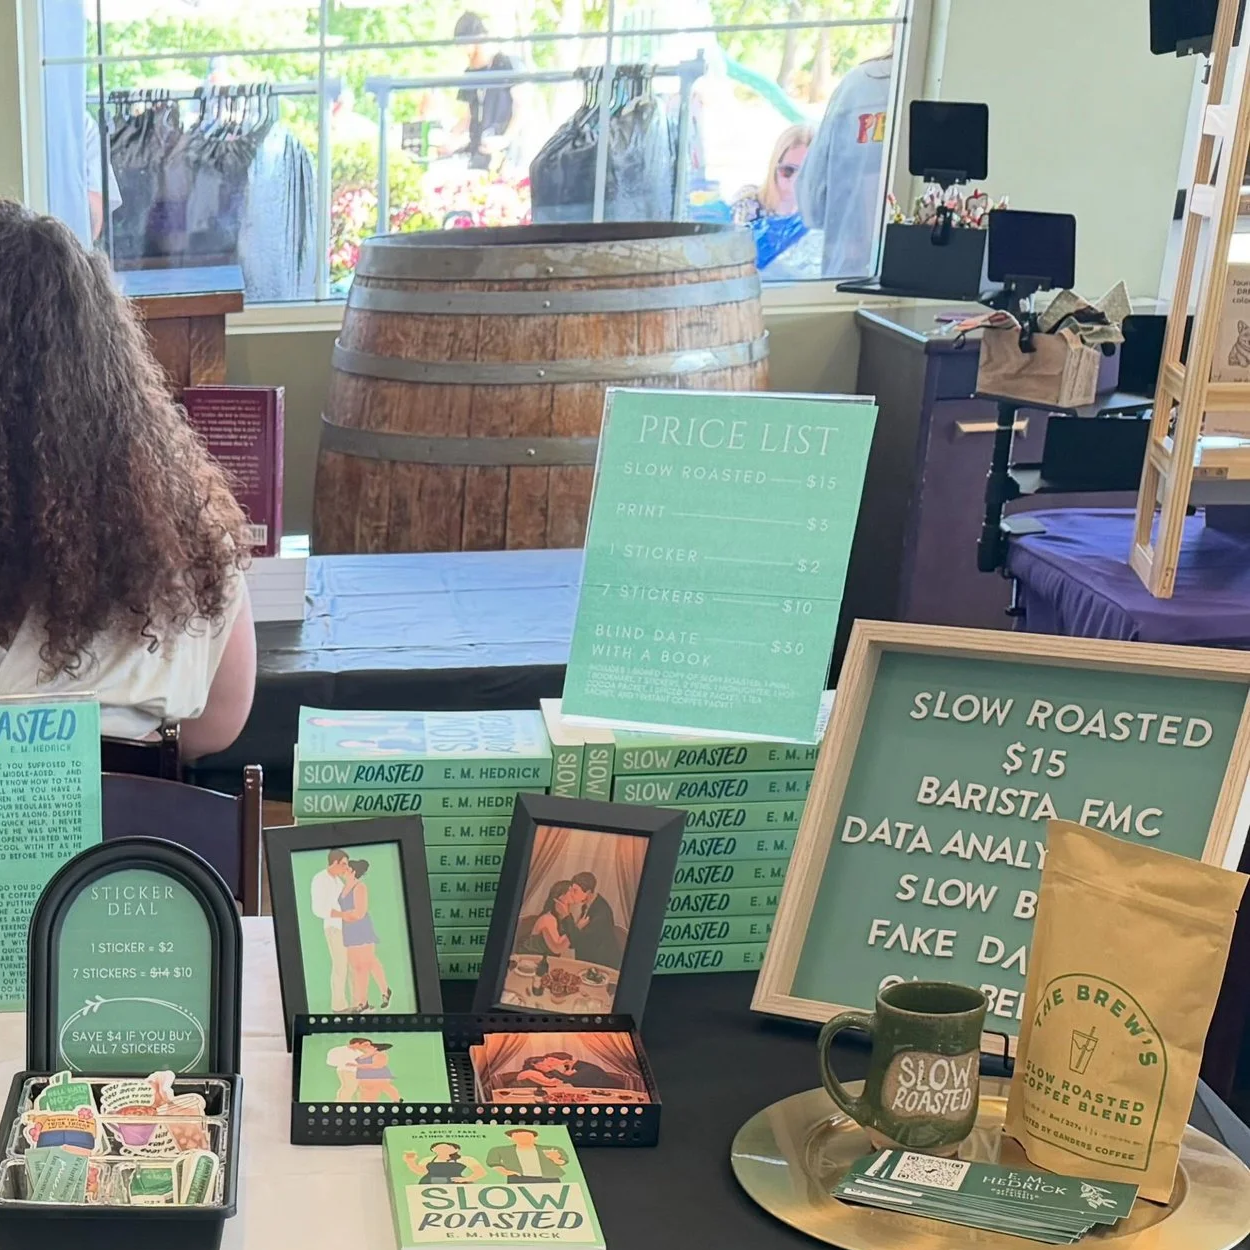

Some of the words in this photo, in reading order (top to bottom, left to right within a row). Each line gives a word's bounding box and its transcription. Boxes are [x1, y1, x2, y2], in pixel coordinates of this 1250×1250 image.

[639, 415, 748, 449] PRICE
[760, 423, 839, 456] LIST
[624, 463, 674, 477] SLOW
[682, 466, 767, 484] ROASTED
[806, 475, 837, 490] $15
[616, 503, 665, 518] PRINT
[624, 544, 698, 562] STICKER
[796, 559, 820, 574] $2
[620, 587, 705, 604] STICKERS
[782, 600, 813, 614] $10
[595, 624, 644, 639] BLIND
[654, 629, 699, 644] DATE
[592, 644, 632, 659] WITH
[661, 650, 711, 666] BOOK
[909, 691, 1015, 727] SLOW
[1026, 699, 1213, 748] ROASTED
[623, 749, 673, 770] SLOW
[674, 746, 748, 768] ROASTED
[1001, 741, 1068, 778] $15
[304, 765, 351, 784] SLOW
[354, 764, 424, 783] ROASTED
[444, 768, 455, 779] E.
[460, 768, 475, 779] M.
[479, 768, 540, 779] HEDRICK
[304, 794, 350, 813] SLOW
[352, 793, 422, 813] ROASTED
[624, 782, 674, 802] SLOW
[676, 779, 749, 800] ROASTED
[916, 776, 1058, 822] BARISTA
[1079, 798, 1164, 837] FMC
[841, 815, 933, 854] DATA
[940, 829, 1049, 870] ANALY
[91, 886, 174, 900] STICKER
[895, 873, 999, 913] SLOW
[108, 903, 158, 916] DEAL
[98, 943, 145, 953] STICKER
[159, 942, 174, 953] $2
[72, 969, 78, 979] 7
[82, 968, 136, 979] STICKERS
[173, 967, 192, 978] $10
[1035, 988, 1064, 1028] THE
[72, 1032, 102, 1042] SAVE
[107, 1031, 121, 1042] $4
[126, 1032, 135, 1041] IF
[139, 1031, 166, 1041] YOU
[169, 1031, 192, 1040] BUY
[88, 1044, 107, 1054] ALL
[121, 1044, 175, 1054] STICKERS
[898, 1055, 973, 1092] SLOW
[1025, 1059, 1055, 1085] SLOW
[1062, 1080, 1145, 1112] ROASTED
[892, 1088, 971, 1115] ROASTED
[1022, 1073, 1070, 1106] COFFEE
[1078, 1102, 1142, 1126] BLEND
[1053, 1131, 1092, 1151] GANDERS
[1095, 1146, 1135, 1161] COFFEE
[421, 1185, 570, 1210] SLOW
[982, 1175, 1068, 1195] HEDRICK
[417, 1211, 583, 1231] ROASTED
